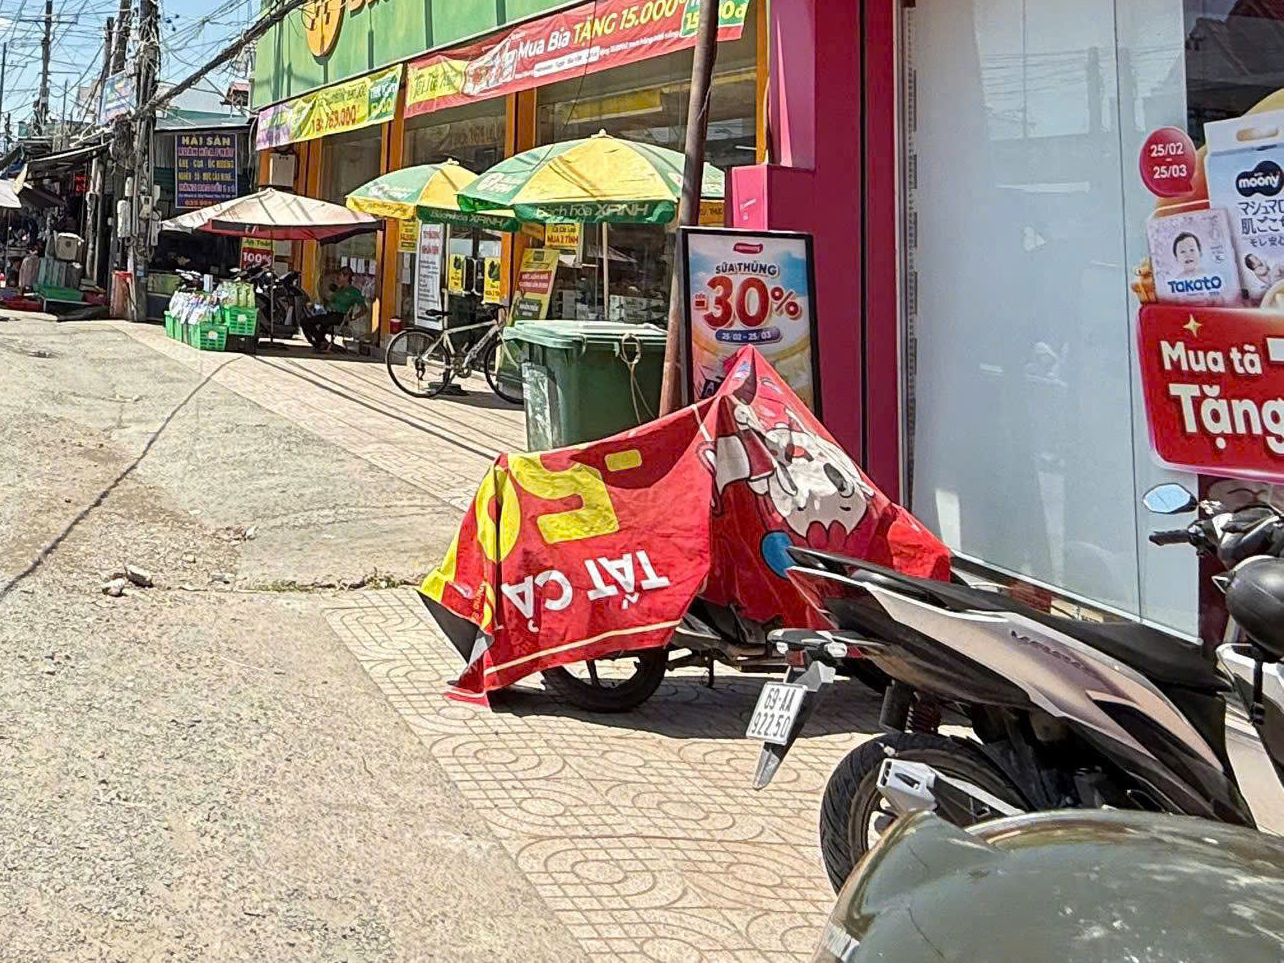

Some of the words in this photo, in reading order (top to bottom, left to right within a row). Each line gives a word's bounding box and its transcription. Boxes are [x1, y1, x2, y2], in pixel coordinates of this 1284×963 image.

[517, 37, 545, 61] Mua
[547, 26, 572, 53] Bia
[572, 12, 618, 46] TẶNG
[181, 134, 203, 146] HẢI
[206, 134, 231, 146] SẢN
[1149, 141, 1185, 157] 25/02
[1152, 164, 1187, 179] 25/03
[1238, 175, 1280, 189] moony
[243, 251, 272, 267] 100%
[715, 261, 734, 275] SỮA
[1160, 340, 1225, 374] Mua
[1230, 344, 1263, 375] tã
[1168, 384, 1284, 454] Tặng
[586, 548, 671, 611] TẤT
[501, 569, 574, 633] CẢ
